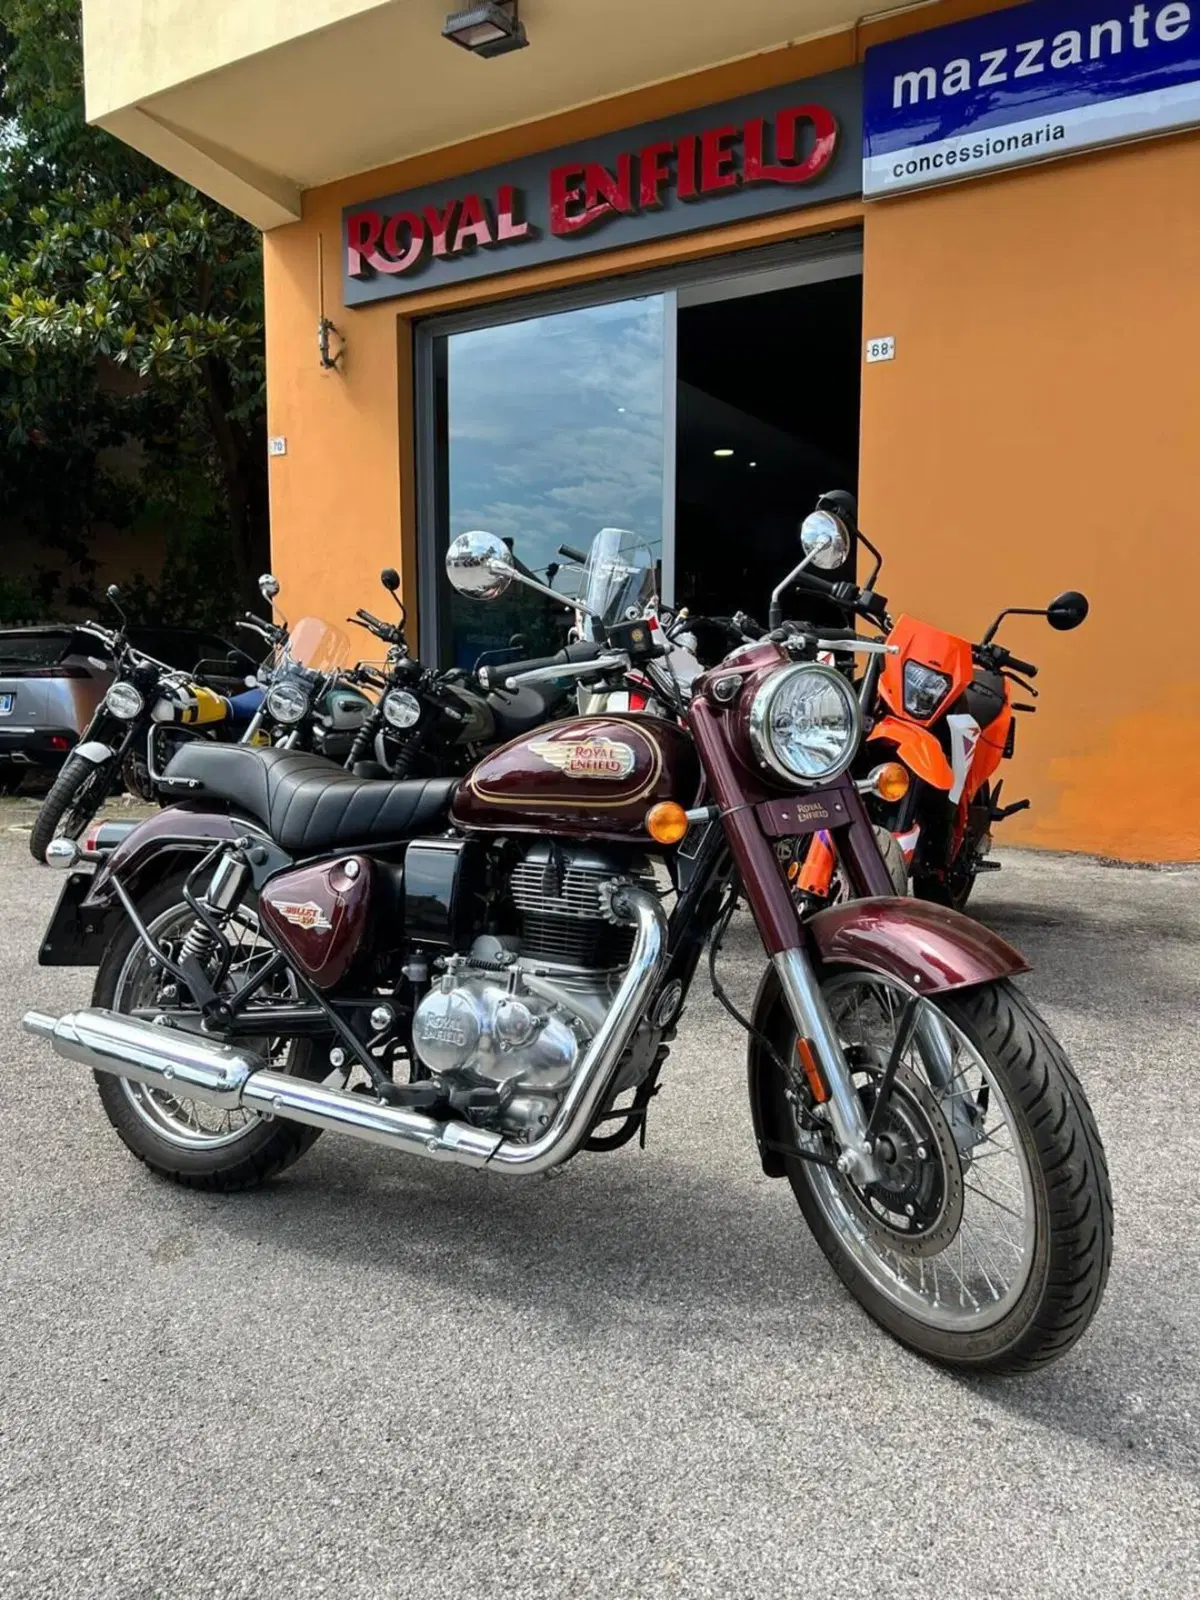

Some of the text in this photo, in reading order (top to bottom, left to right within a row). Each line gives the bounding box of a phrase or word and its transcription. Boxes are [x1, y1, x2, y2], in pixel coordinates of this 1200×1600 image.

[893, 2, 1191, 108] mazzante
[892, 124, 1065, 178] concessionaria
[347, 103, 838, 277] ROYAL ENFIELD
[871, 342, 889, 357] 68
[575, 746, 615, 759] ROYAL
[570, 759, 621, 772] ENFIELD
[797, 802, 823, 814] ROYAL
[798, 809, 829, 823] ENFIELD
